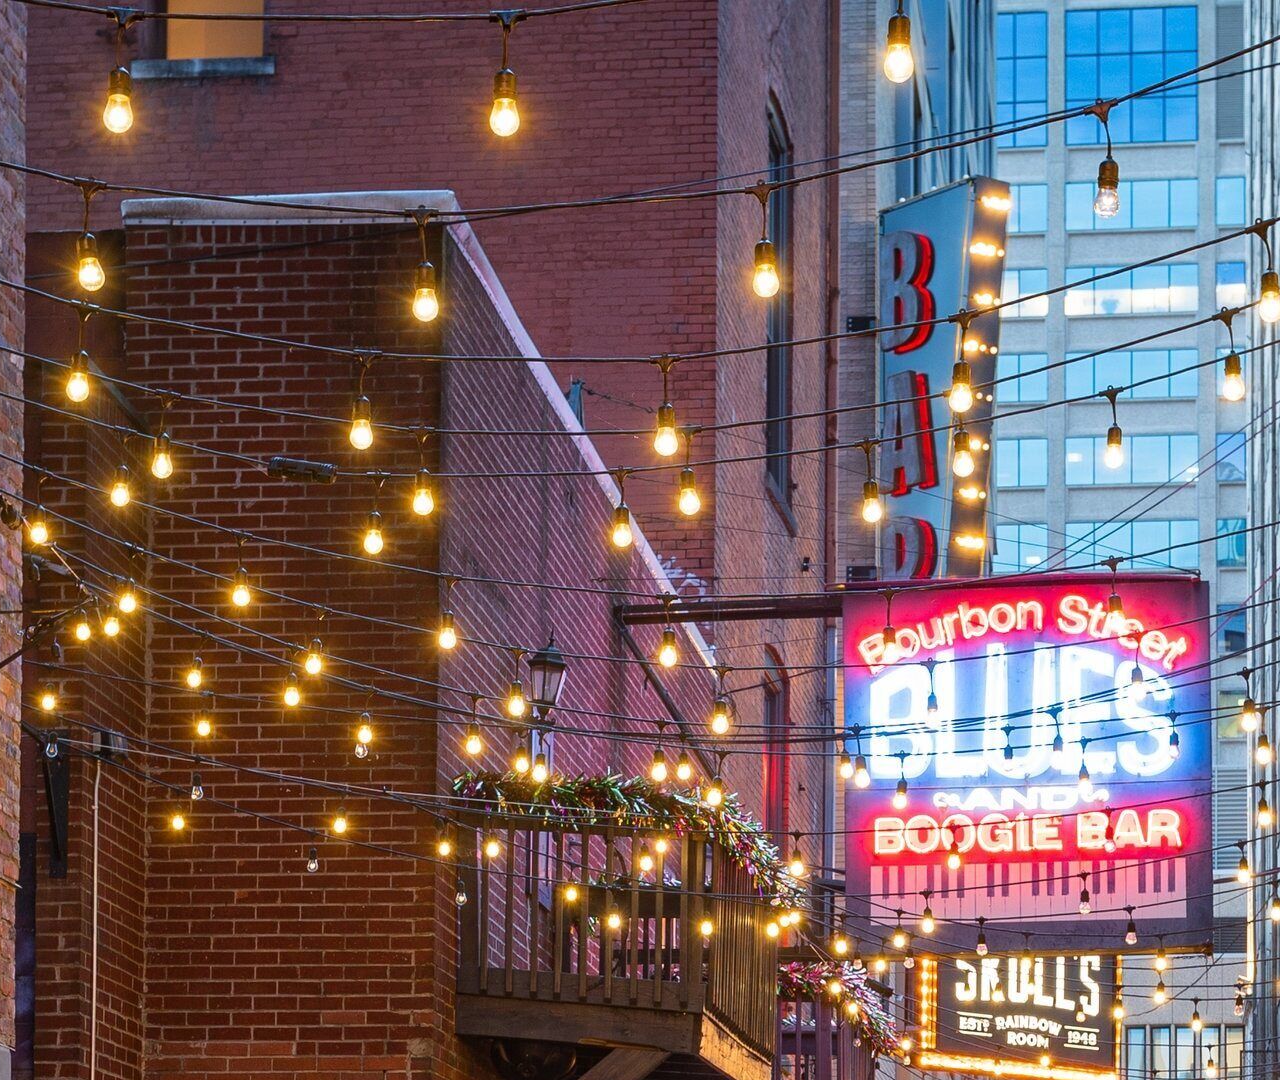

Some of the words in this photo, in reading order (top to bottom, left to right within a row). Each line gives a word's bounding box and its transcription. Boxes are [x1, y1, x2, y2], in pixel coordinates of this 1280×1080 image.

[857, 600, 1043, 675] Bourbon
[1057, 595, 1187, 670] Street
[868, 641, 1176, 779] BLUES
[964, 787, 1077, 811] AND
[873, 813, 1064, 855] BOOGIE
[1076, 808, 1182, 852] BAR
[995, 1015, 1063, 1036] RAINBOW
[1067, 1030, 1097, 1046] 1948
[1006, 1031, 1050, 1049] ROOM
